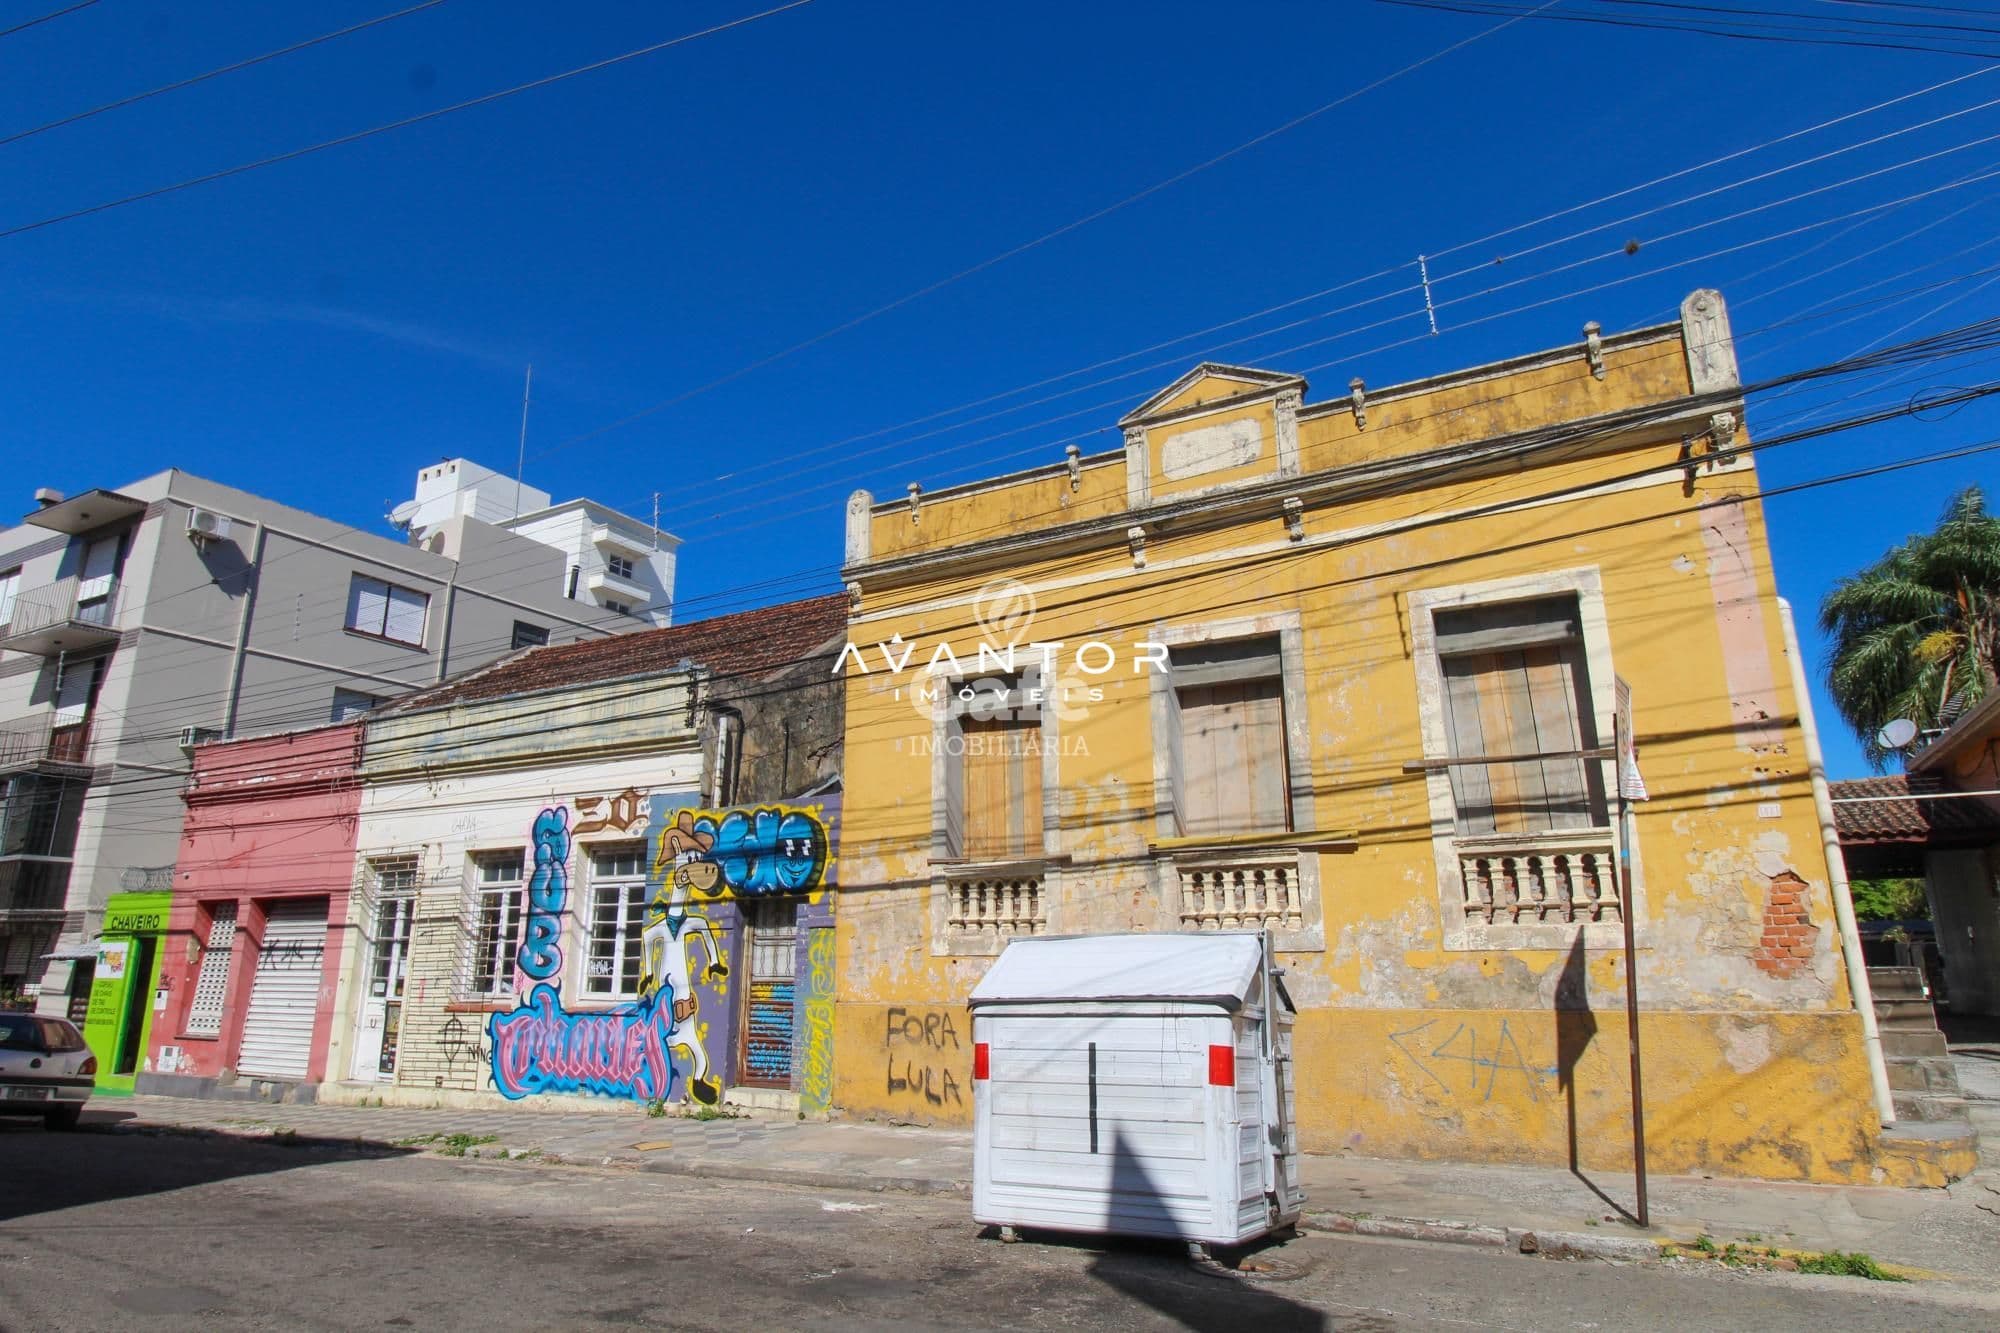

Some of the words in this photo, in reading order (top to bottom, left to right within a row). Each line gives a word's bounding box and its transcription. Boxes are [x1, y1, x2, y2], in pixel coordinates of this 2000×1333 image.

[111, 914, 160, 931] CHAVEIRO
[886, 1007, 960, 1050] FORA
[887, 1053, 962, 1106] LULA
